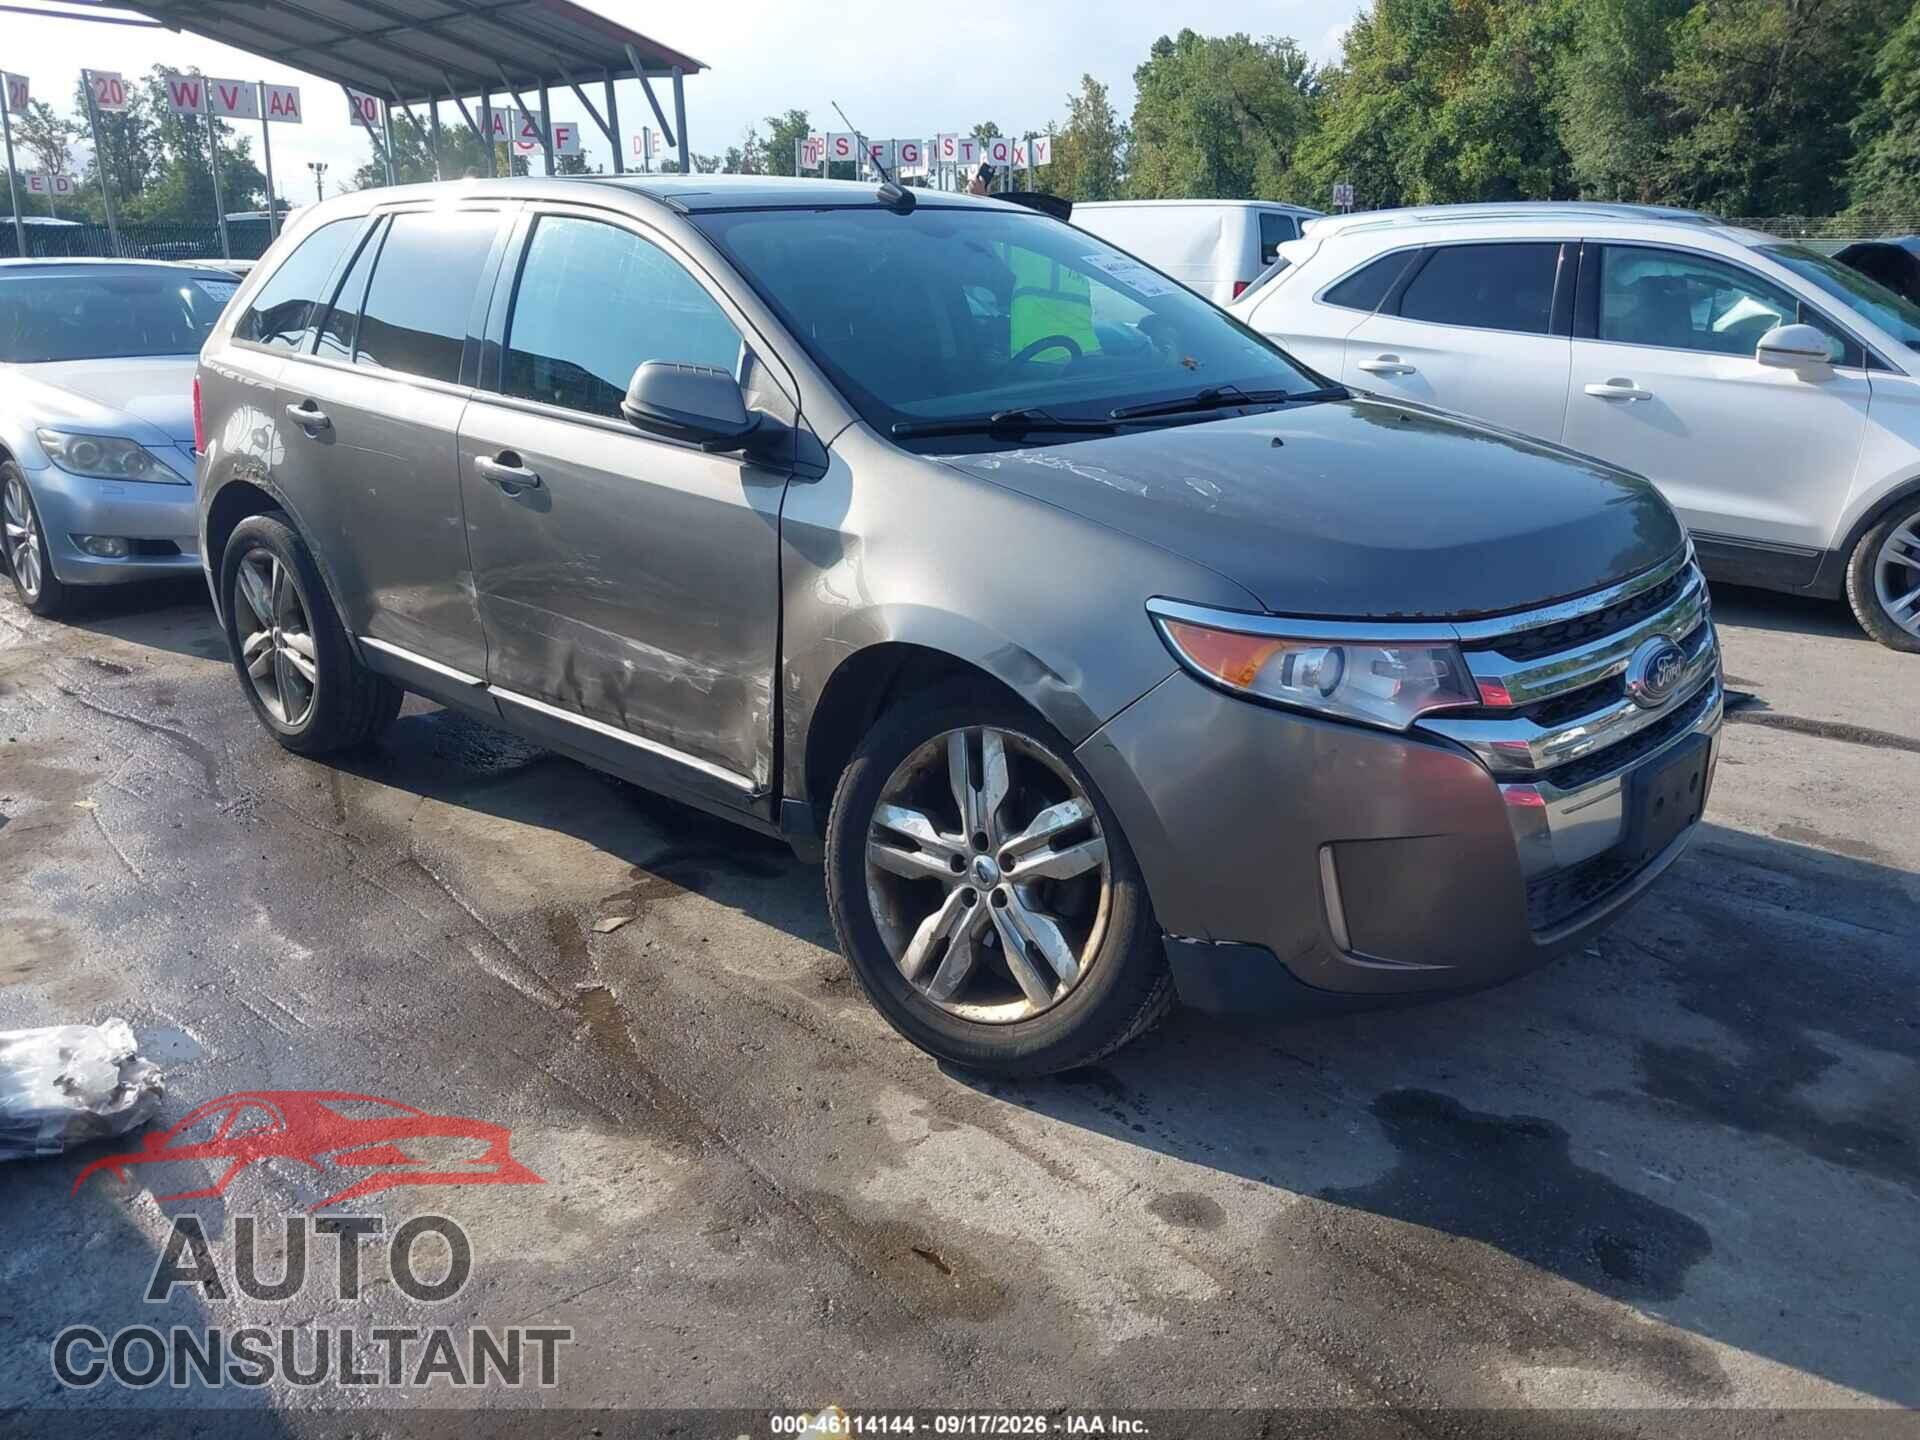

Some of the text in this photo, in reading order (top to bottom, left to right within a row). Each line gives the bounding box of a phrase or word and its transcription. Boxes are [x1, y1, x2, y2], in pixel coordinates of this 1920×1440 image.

[9, 81, 28, 108] 20
[96, 78, 122, 105] 20
[170, 81, 198, 108] W
[219, 85, 238, 110] V
[270, 91, 298, 117] AA
[556, 128, 569, 149] F
[633, 136, 642, 154] D
[651, 132, 660, 152] E
[836, 137, 849, 156] S
[944, 139, 954, 156] S
[802, 145, 817, 164] 70
[902, 144, 918, 162] G
[962, 143, 973, 160] T
[993, 143, 1007, 162] Q
[1036, 142, 1046, 160] Y
[31, 177, 42, 191] E
[57, 178, 69, 191] D
[1656, 653, 1684, 687] Ford
